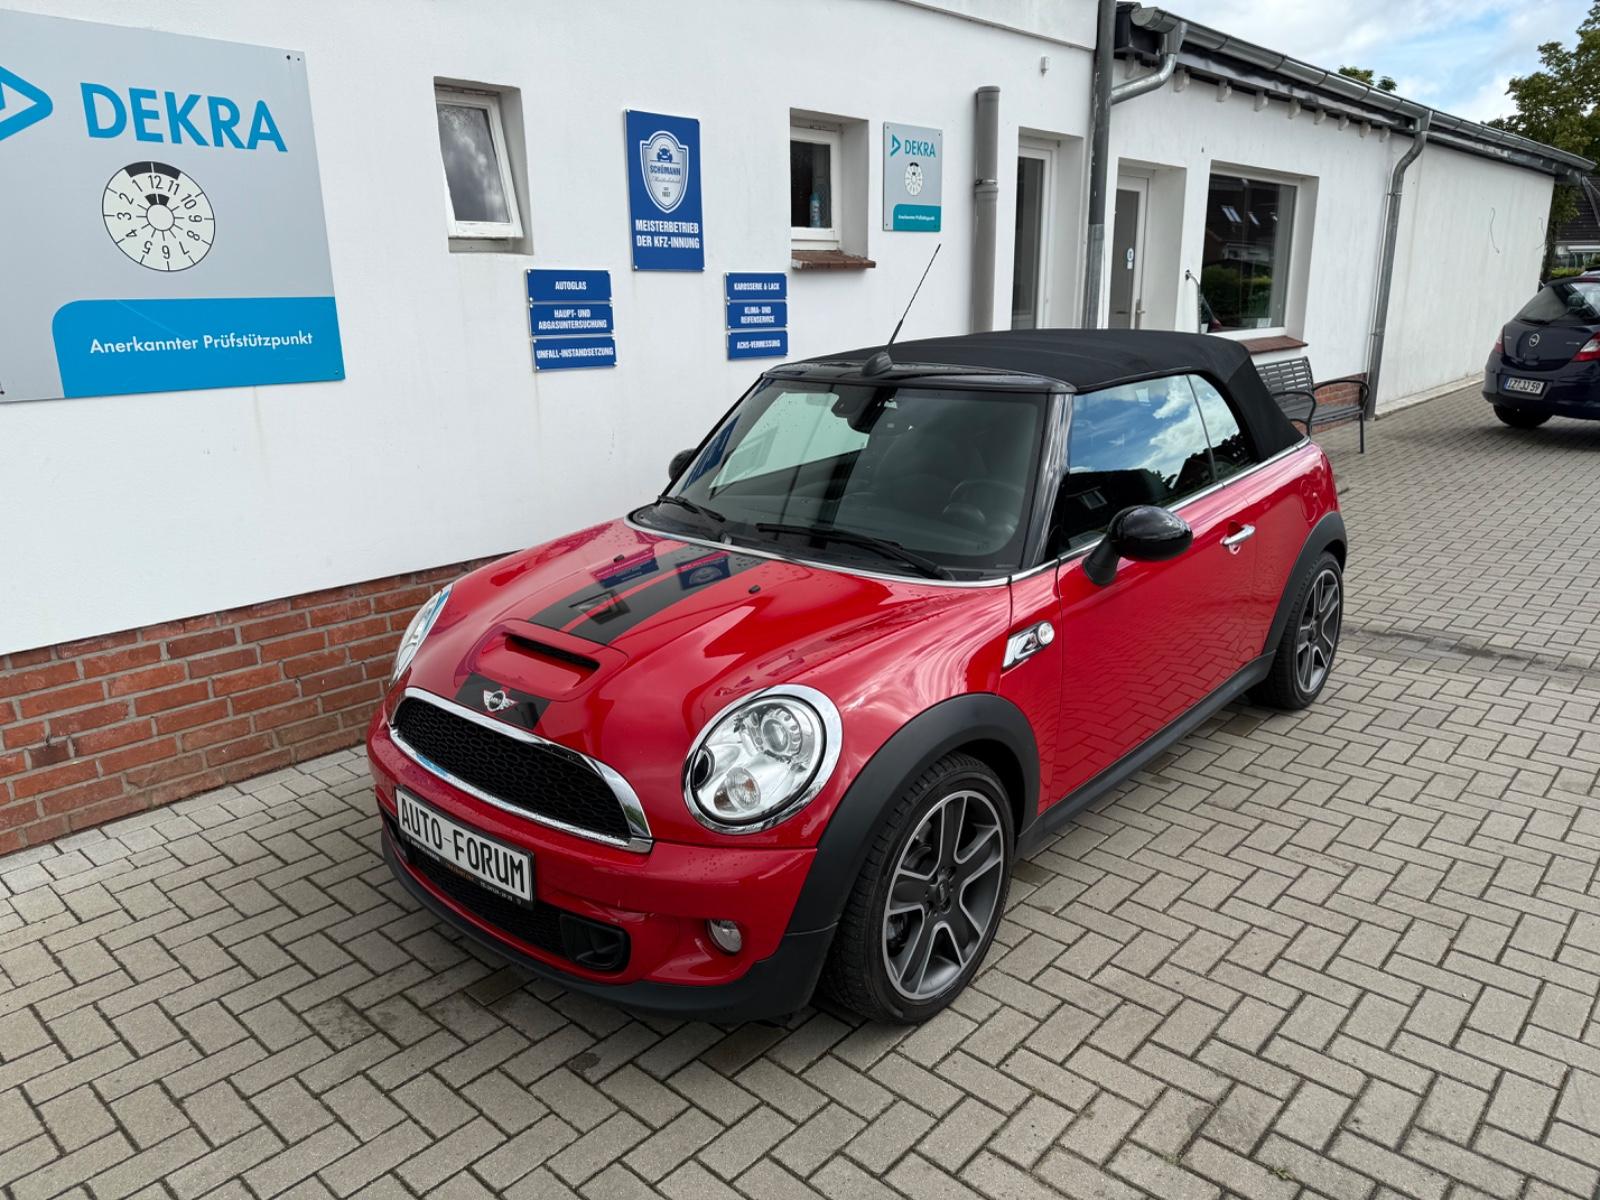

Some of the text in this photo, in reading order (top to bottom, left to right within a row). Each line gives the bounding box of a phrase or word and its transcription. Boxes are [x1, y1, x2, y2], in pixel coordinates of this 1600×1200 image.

[80, 82, 288, 153] DEKRA
[904, 139, 936, 158] DEKRA
[132, 179, 143, 192] 1
[148, 174, 163, 189] 12
[168, 180, 180, 195] 11
[118, 192, 134, 205] 2
[181, 193, 197, 210] 10
[117, 212, 132, 221] 3
[188, 214, 203, 223] 9
[125, 229, 138, 238] 4
[635, 219, 699, 234] MEISTERBETRIEB
[186, 230, 200, 241] 8
[636, 234, 700, 249] DER KFZ-INNUNG
[142, 241, 153, 255] 5
[161, 245, 171, 260] 6
[179, 241, 190, 255] 7
[555, 281, 587, 290] AUTOGLAS
[734, 282, 763, 290] KAROSSERIE
[554, 308, 591, 318] HAUPT- UND
[538, 319, 608, 330] ABGASUNTERSUCHUNG
[90, 331, 313, 354] Anerkannter Prüfstützpunkt
[536, 346, 614, 359] UNFALL-INSTANDSETZUNG
[401, 798, 525, 894] AUTO-FORUM
